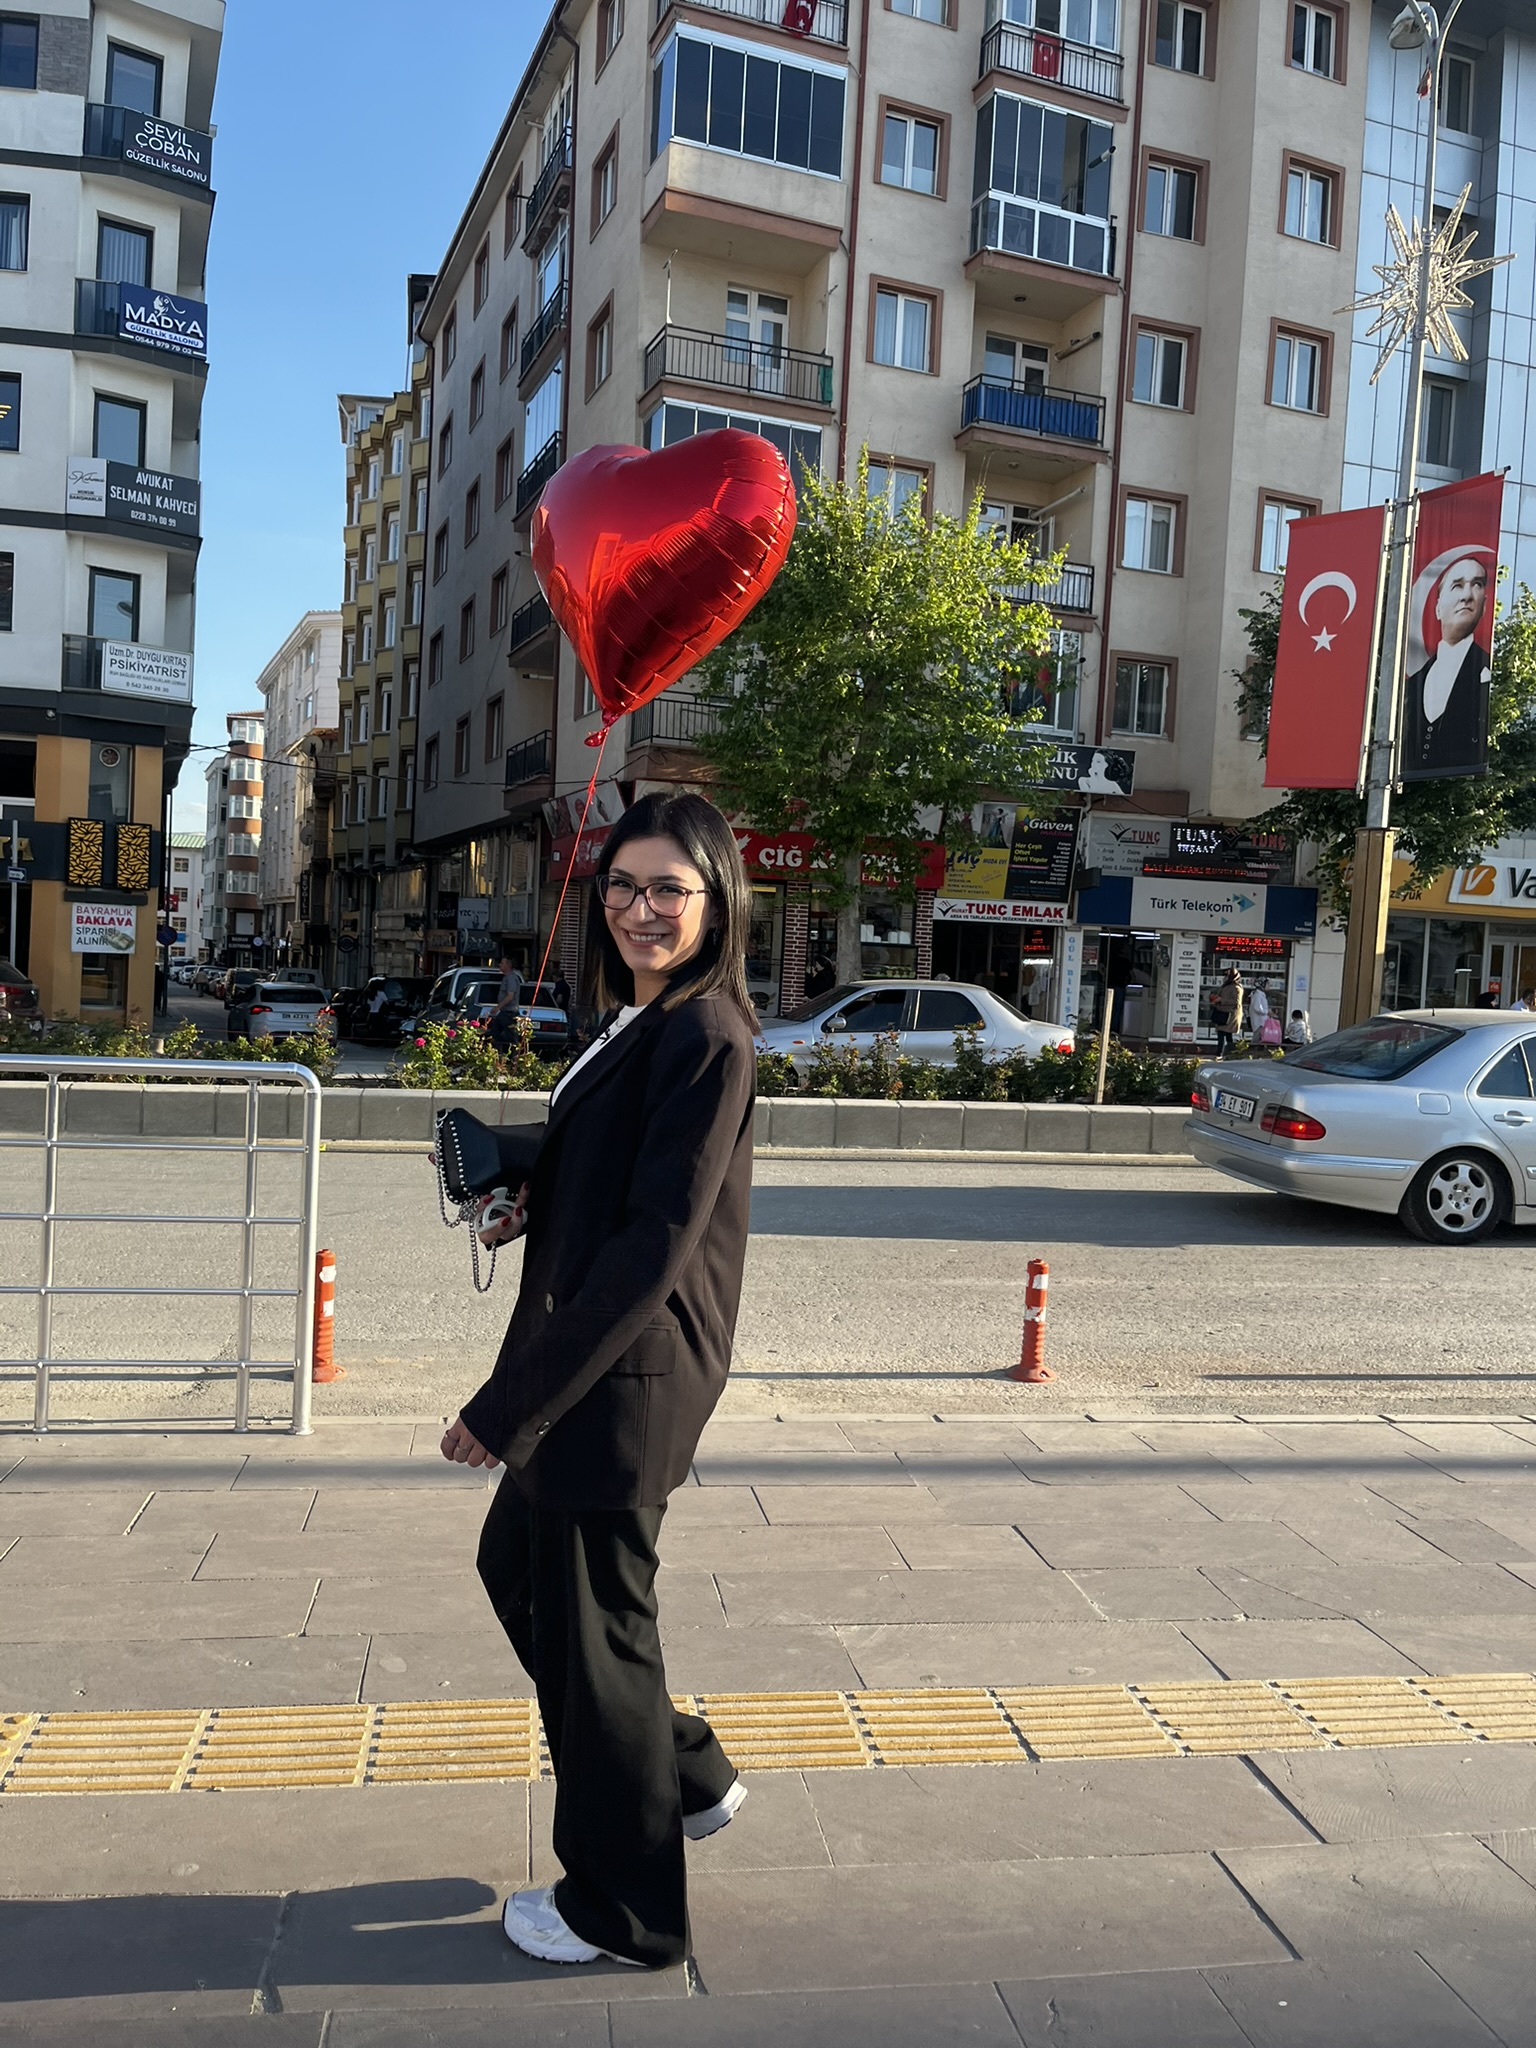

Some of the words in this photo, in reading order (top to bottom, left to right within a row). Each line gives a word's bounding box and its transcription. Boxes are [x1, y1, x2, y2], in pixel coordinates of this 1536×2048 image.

[143, 120, 192, 148] SEVİL
[135, 132, 200, 164] ÇOBAN
[126, 148, 170, 171] GÜZELLİK
[171, 164, 207, 182] SALONU
[125, 302, 204, 338] MADYA
[130, 324, 167, 339] GÜZELLİK
[168, 333, 199, 346] SALONU
[182, 347, 192, 355] 02
[135, 471, 174, 491] AVUKAT
[110, 485, 151, 506] SELMAN
[155, 494, 197, 516] KAHVECİ
[109, 658, 187, 679] PSİKİYATRİST
[136, 650, 162, 663] DUYGU
[162, 654, 188, 669] KIRTAŞ
[1029, 818, 1074, 831] Güven
[1131, 830, 1161, 845] TUNÇ
[758, 844, 803, 870] ÇİĞ
[76, 905, 133, 917] BAYRAMLIK
[966, 902, 1008, 916] TUNÇ
[1011, 905, 1065, 919] EMLAK
[1150, 897, 1177, 910] Türk
[1181, 899, 1233, 913] Telekom
[76, 915, 133, 927] BAKLAVA
[1219, 1092, 1227, 1107] 34
[1239, 1099, 1252, 1116] 901
